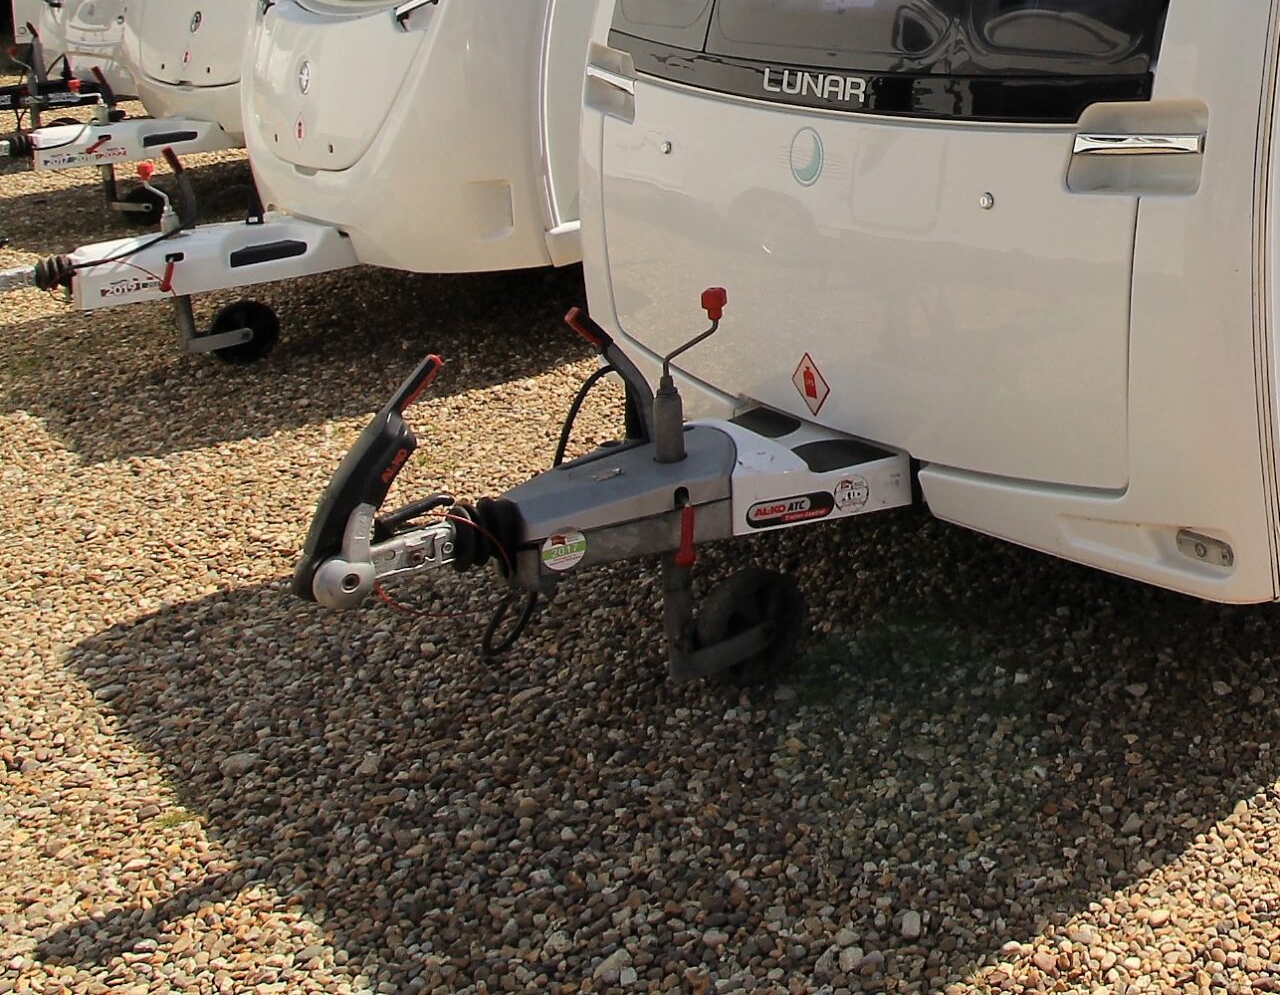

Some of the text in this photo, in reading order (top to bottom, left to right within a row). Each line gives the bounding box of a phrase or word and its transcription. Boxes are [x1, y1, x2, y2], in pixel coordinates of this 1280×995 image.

[763, 67, 867, 103] LUNAR
[105, 283, 137, 297] 2019
[787, 500, 805, 512] ATC
[551, 544, 579, 558] 2017
